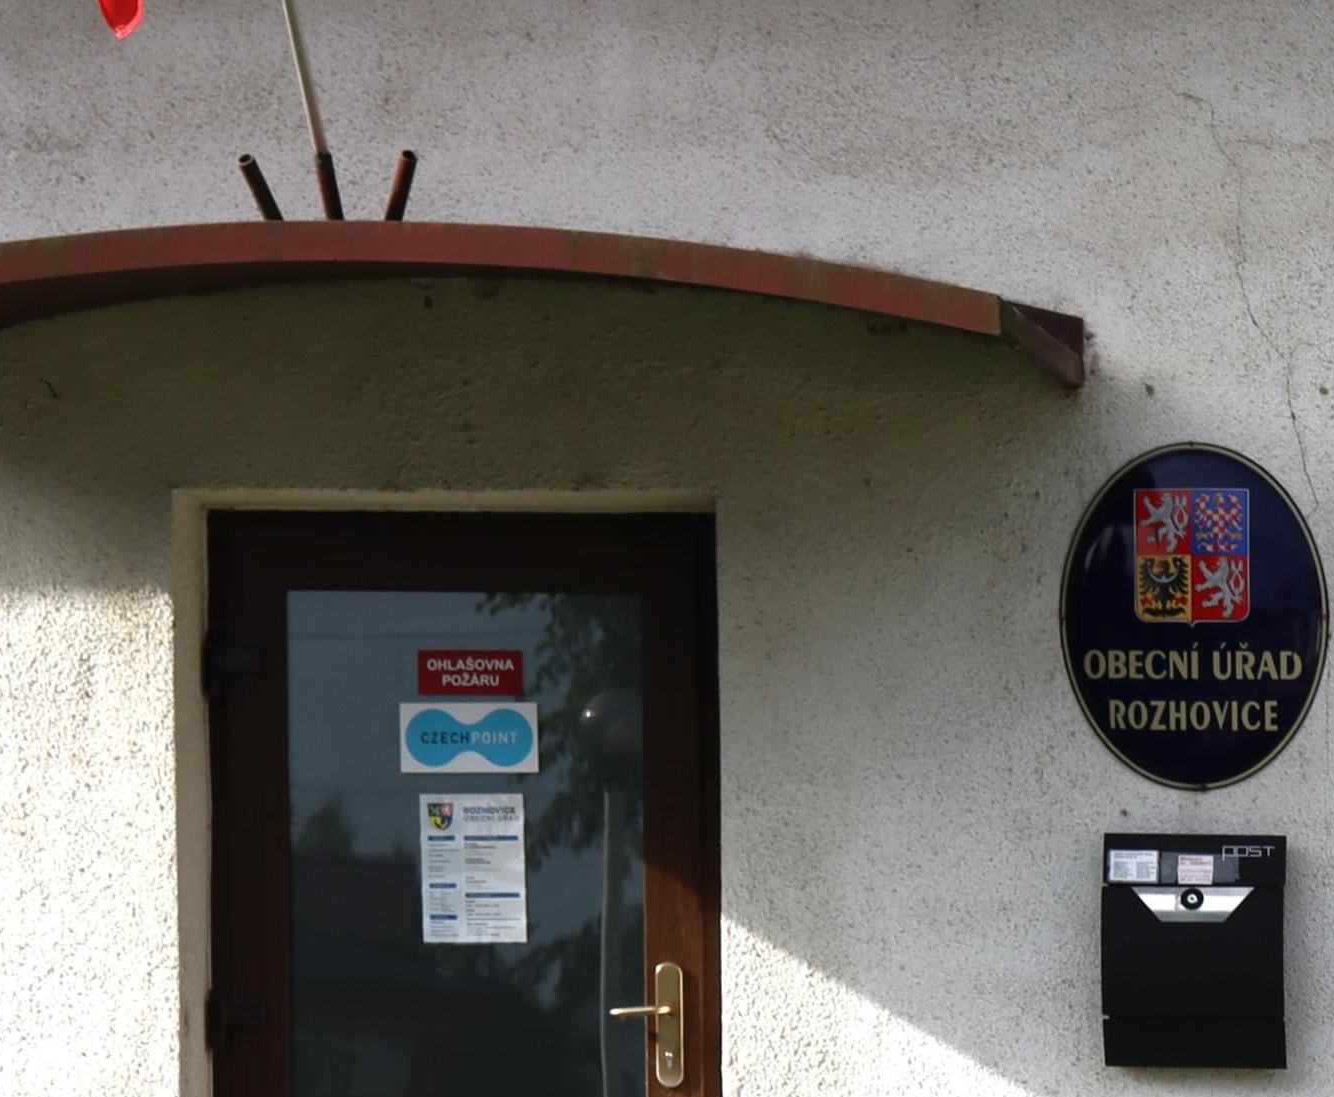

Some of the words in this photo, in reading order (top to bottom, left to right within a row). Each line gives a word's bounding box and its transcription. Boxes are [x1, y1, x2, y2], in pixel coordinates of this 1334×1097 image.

[427, 656, 514, 671] OHLAŠOVNA
[1084, 642, 1199, 680] OBECNÍ
[1213, 642, 1303, 680] ÚŘAD
[442, 672, 500, 686] POŽÁRU
[1109, 699, 1279, 731] ROZHOVICE
